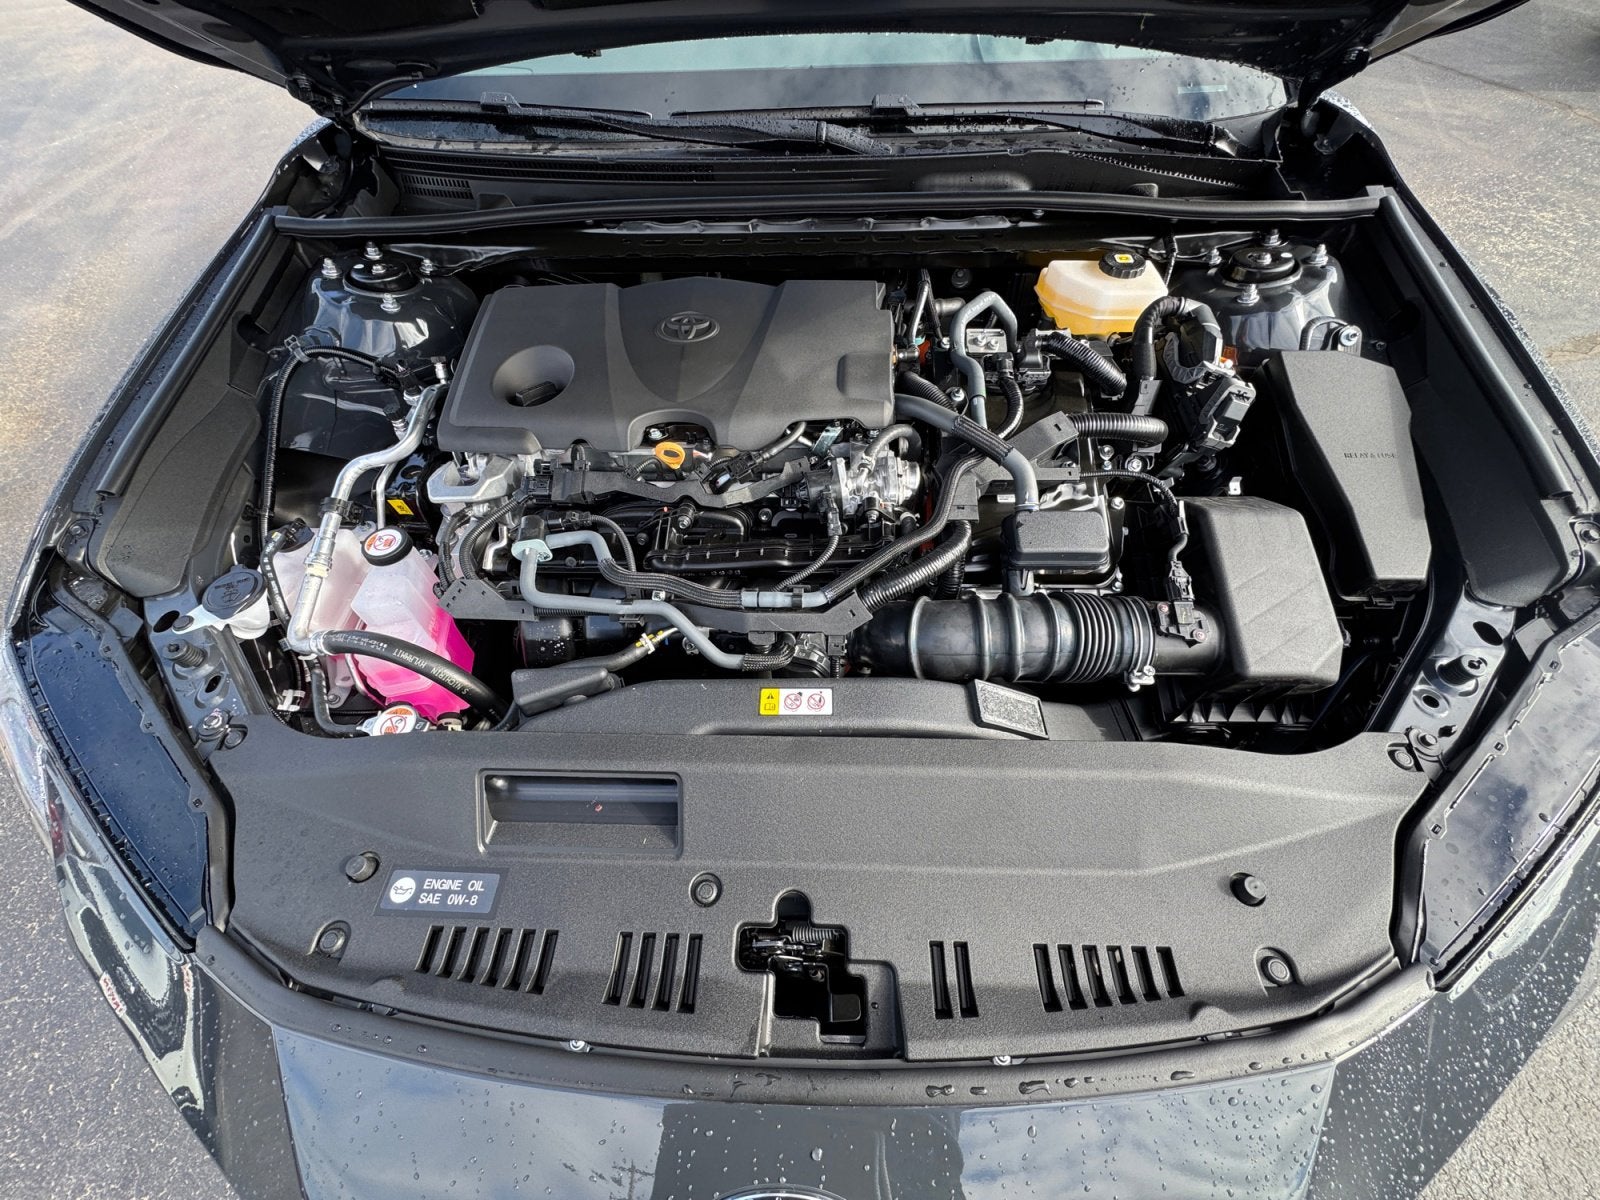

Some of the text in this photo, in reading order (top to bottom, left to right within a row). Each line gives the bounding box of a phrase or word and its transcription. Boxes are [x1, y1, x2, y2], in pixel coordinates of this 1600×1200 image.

[423, 878, 485, 891] ENGINE OIL
[418, 892, 478, 905] SAE 0W-8
